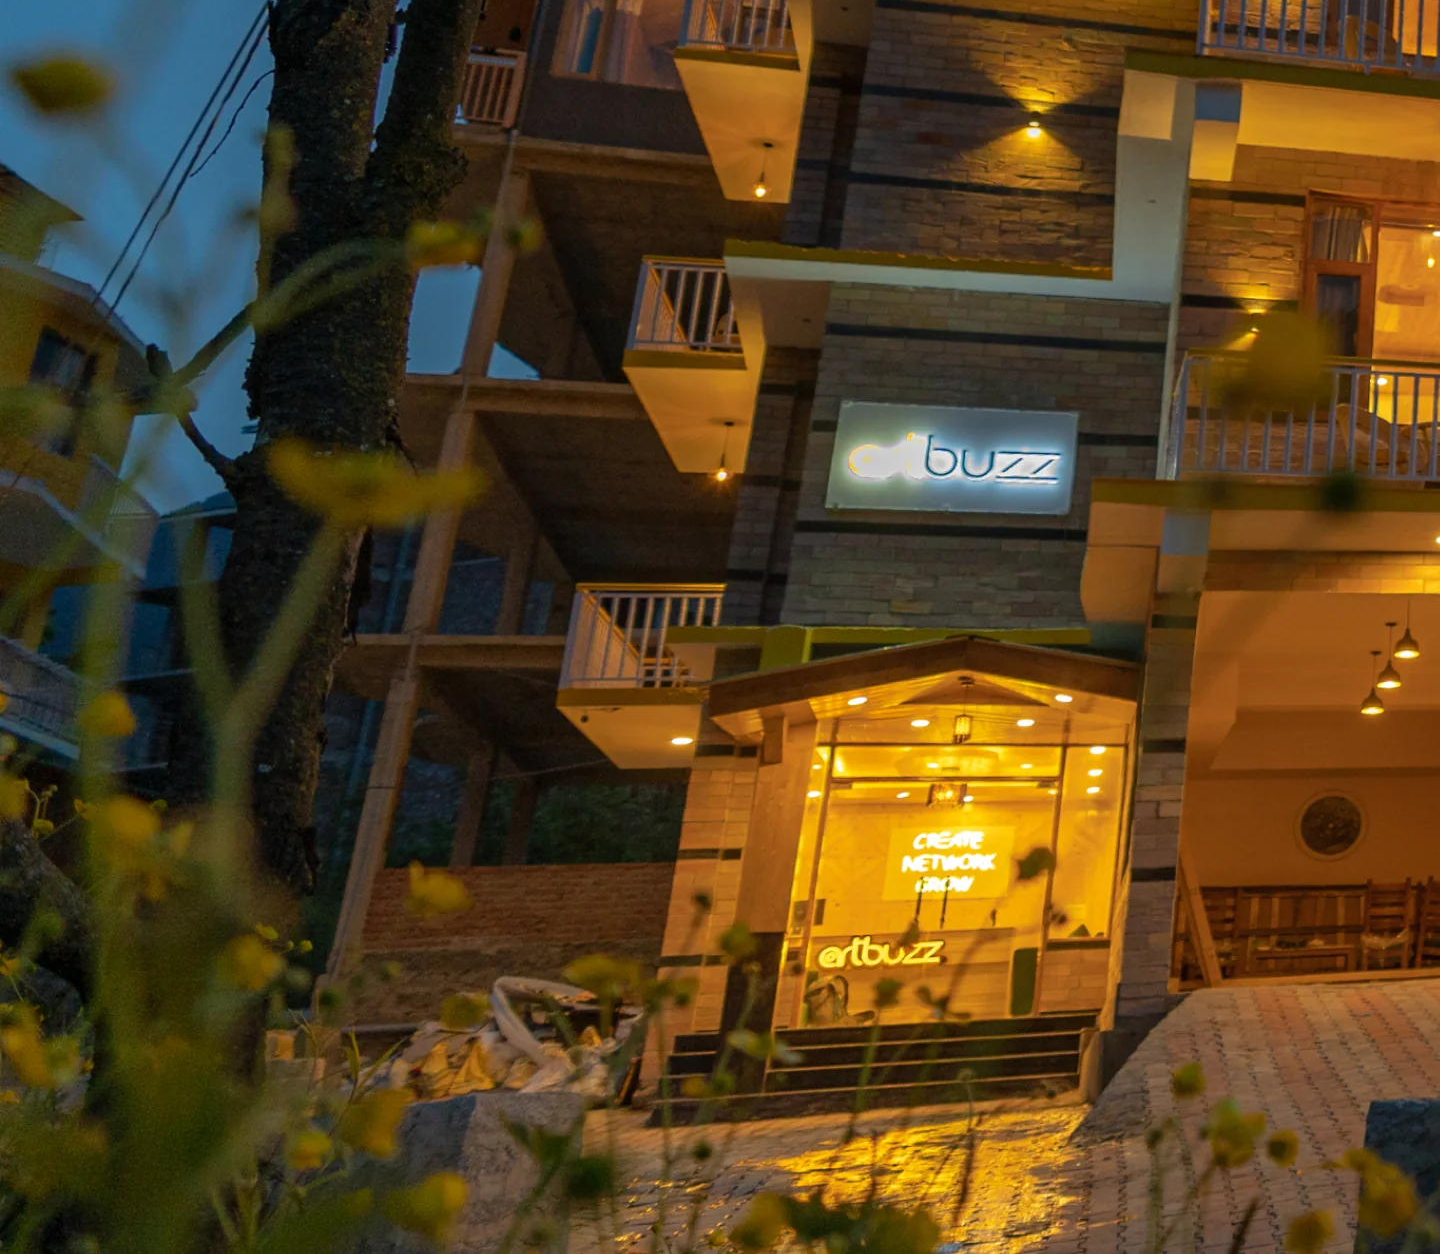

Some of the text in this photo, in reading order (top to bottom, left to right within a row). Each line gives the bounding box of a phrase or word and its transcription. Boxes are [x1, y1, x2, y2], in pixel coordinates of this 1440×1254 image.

[848, 432, 1061, 483] buzz
[913, 831, 983, 849] CREATE
[902, 853, 996, 872] NETWORK
[915, 876, 974, 892] GROW
